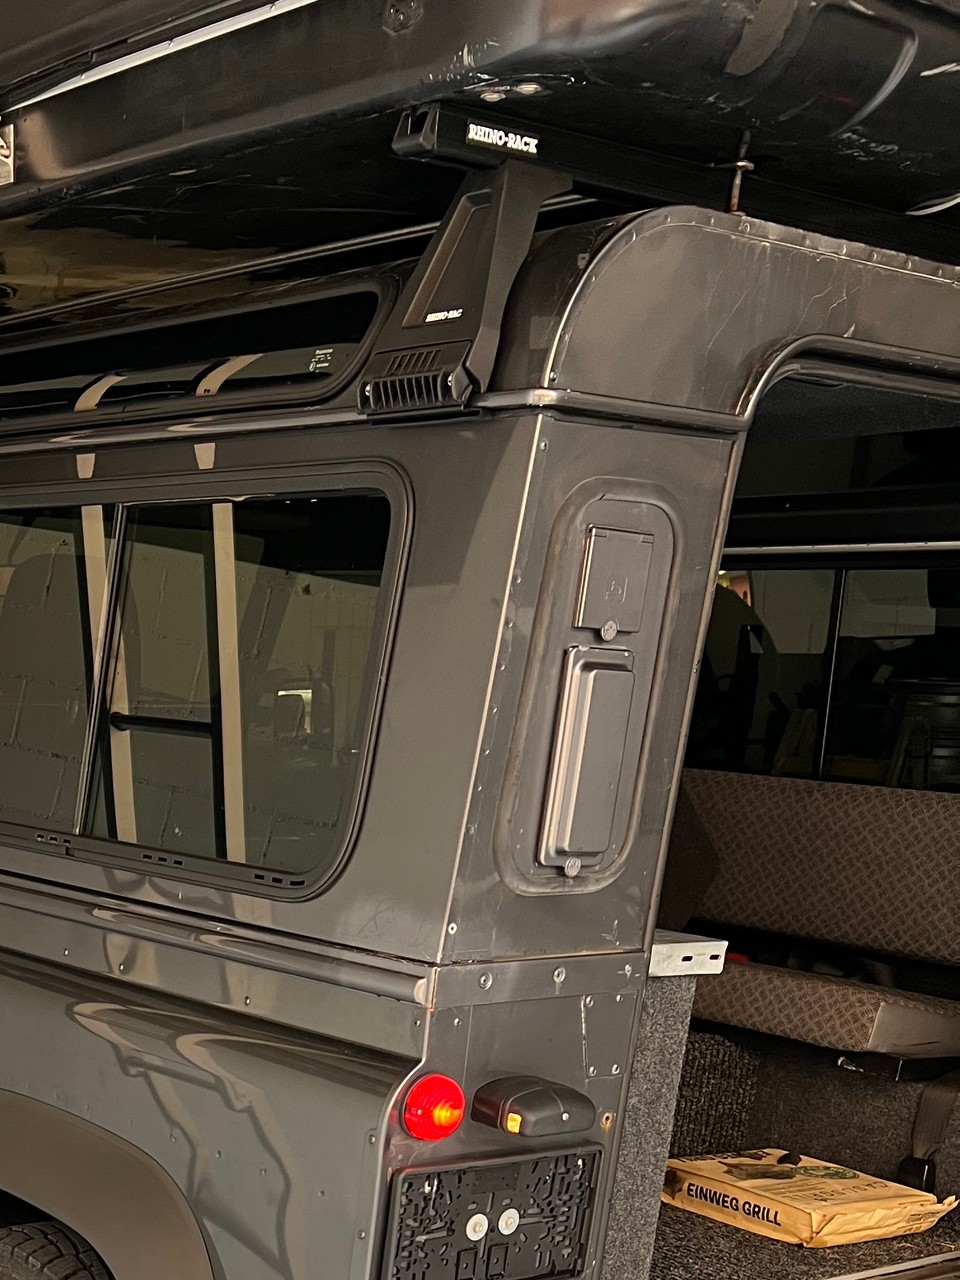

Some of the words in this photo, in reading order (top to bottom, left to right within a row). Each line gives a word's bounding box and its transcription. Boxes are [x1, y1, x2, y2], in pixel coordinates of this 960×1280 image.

[468, 123, 539, 154] RHINO-RACK
[686, 1182, 740, 1212] EINWEG
[741, 1201, 782, 1227] GRILL
